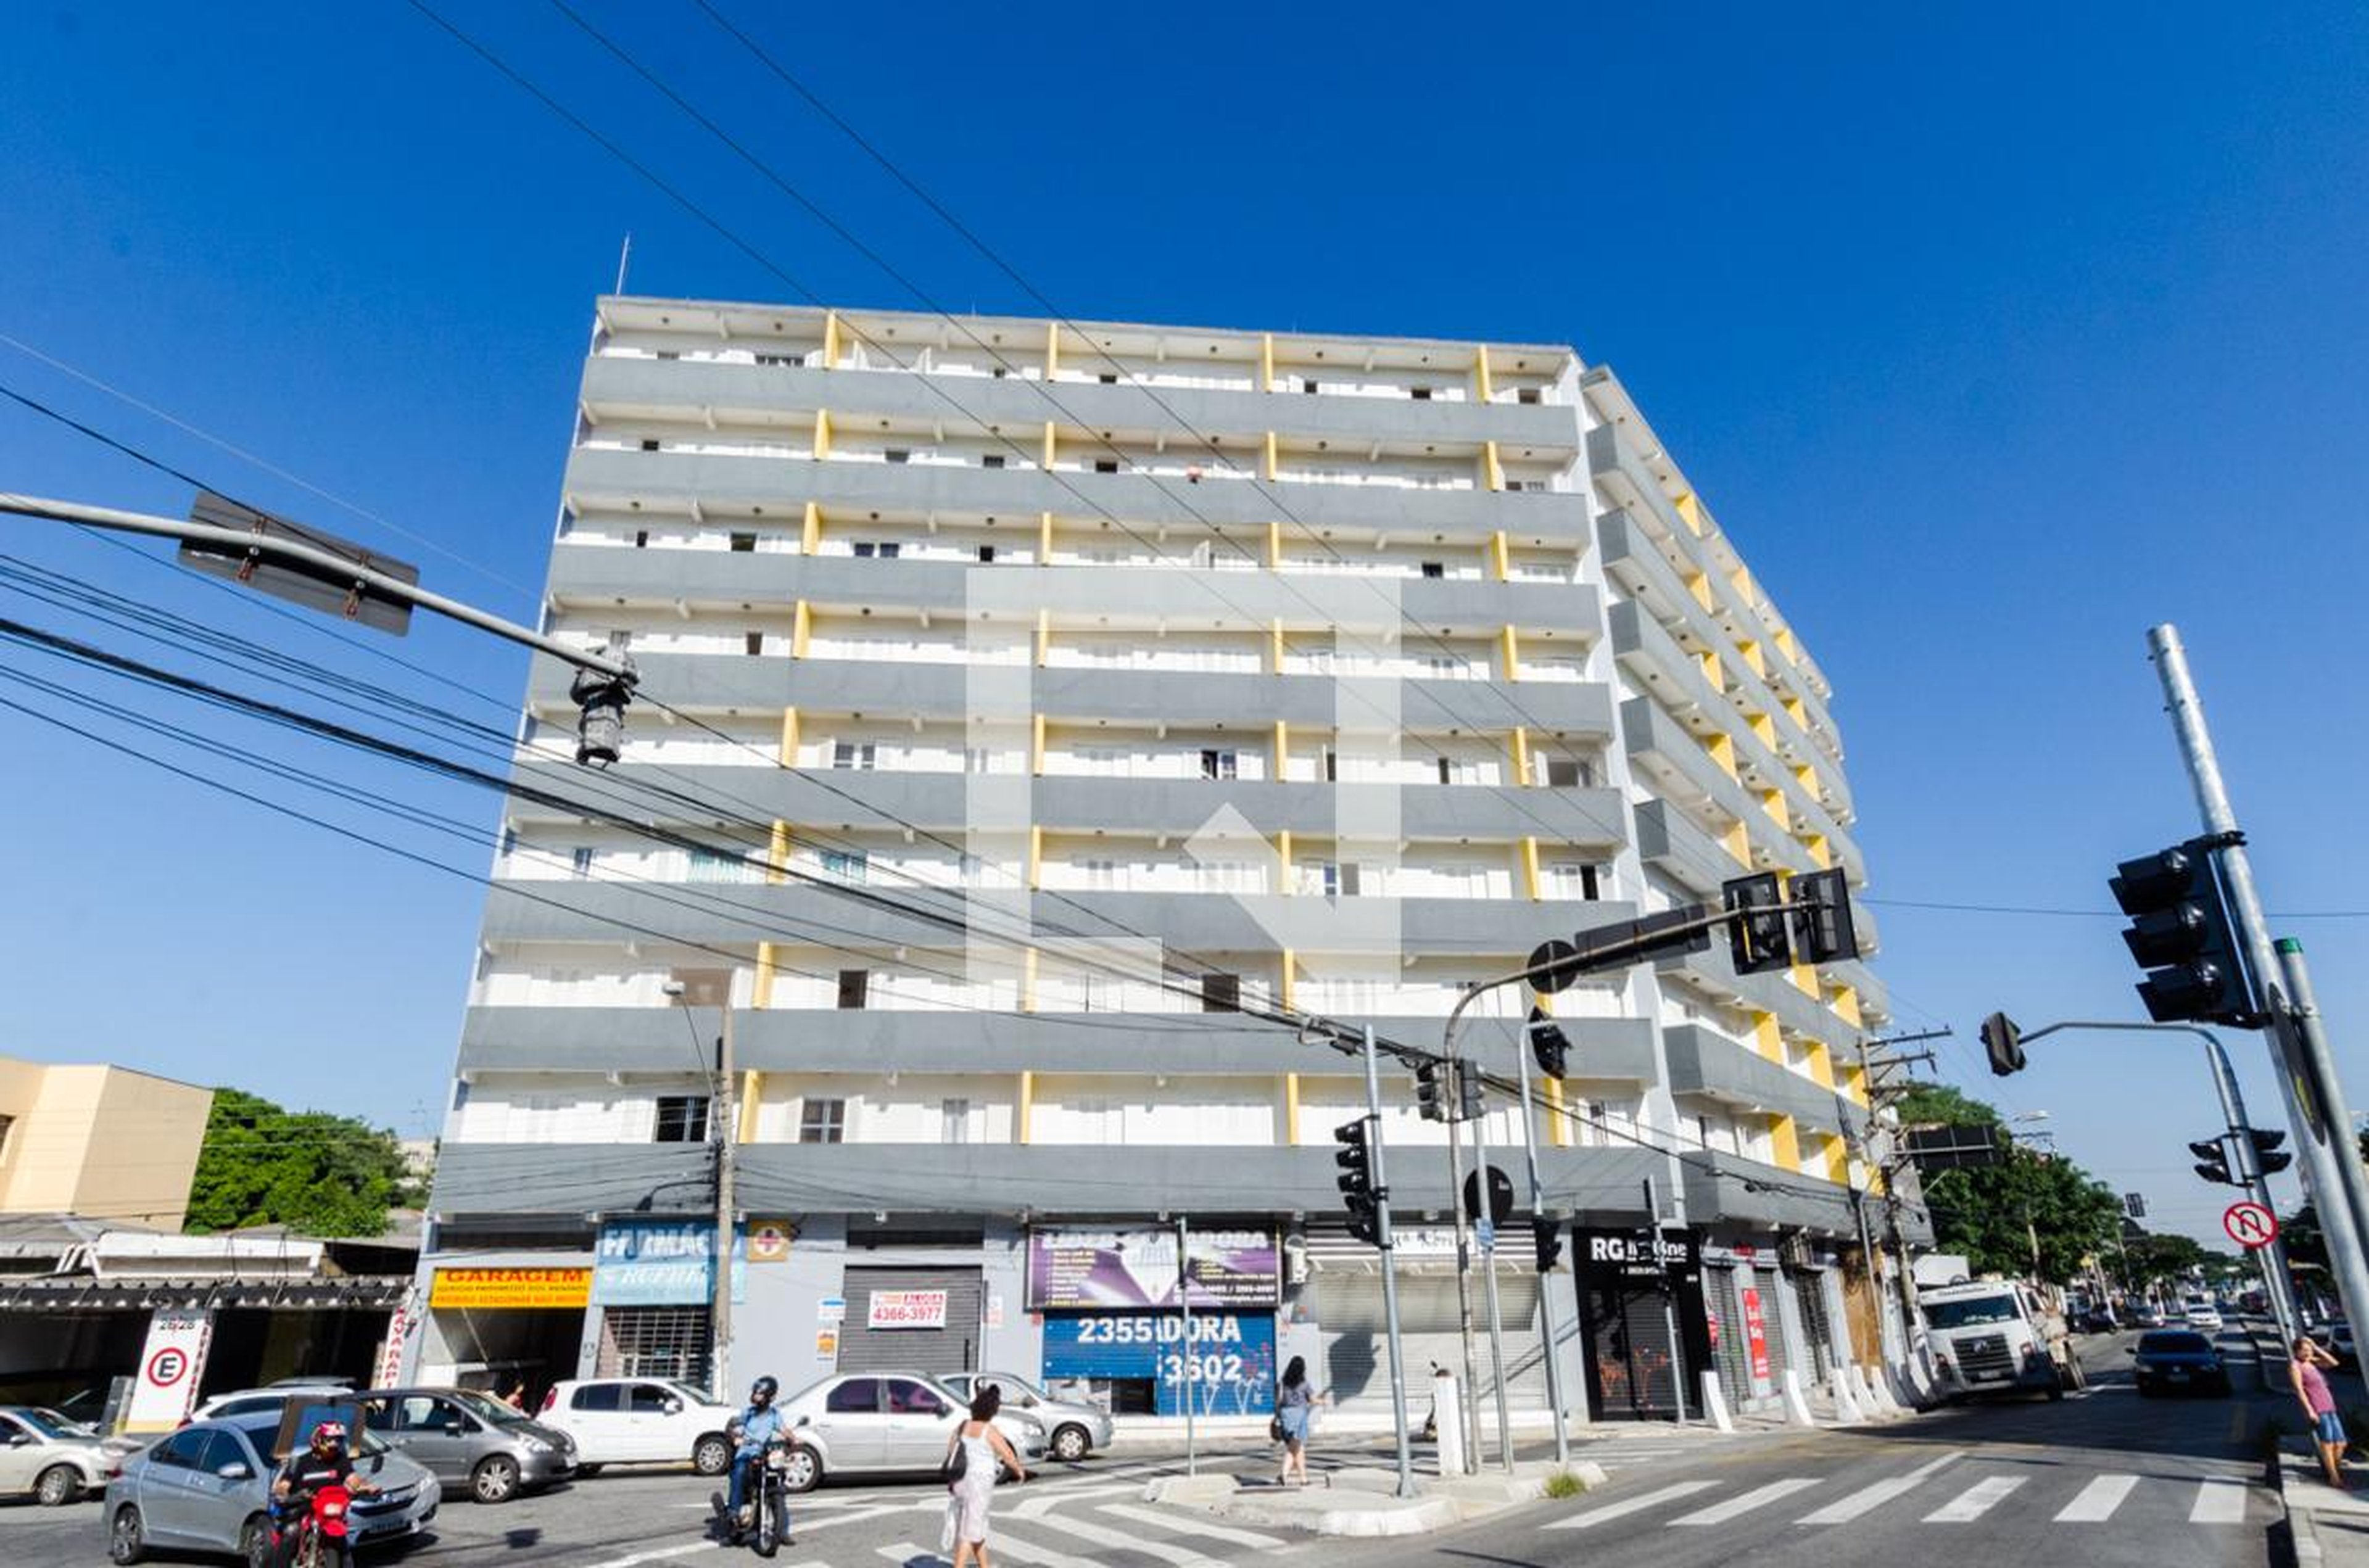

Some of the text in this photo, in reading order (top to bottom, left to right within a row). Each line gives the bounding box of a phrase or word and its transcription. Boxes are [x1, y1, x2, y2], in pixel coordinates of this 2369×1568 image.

[1591, 1237, 1624, 1260] RG
[447, 1268, 583, 1282] GARAGEM
[1078, 1316, 1241, 1343] 2355 DORA
[158, 1357, 178, 1378] E
